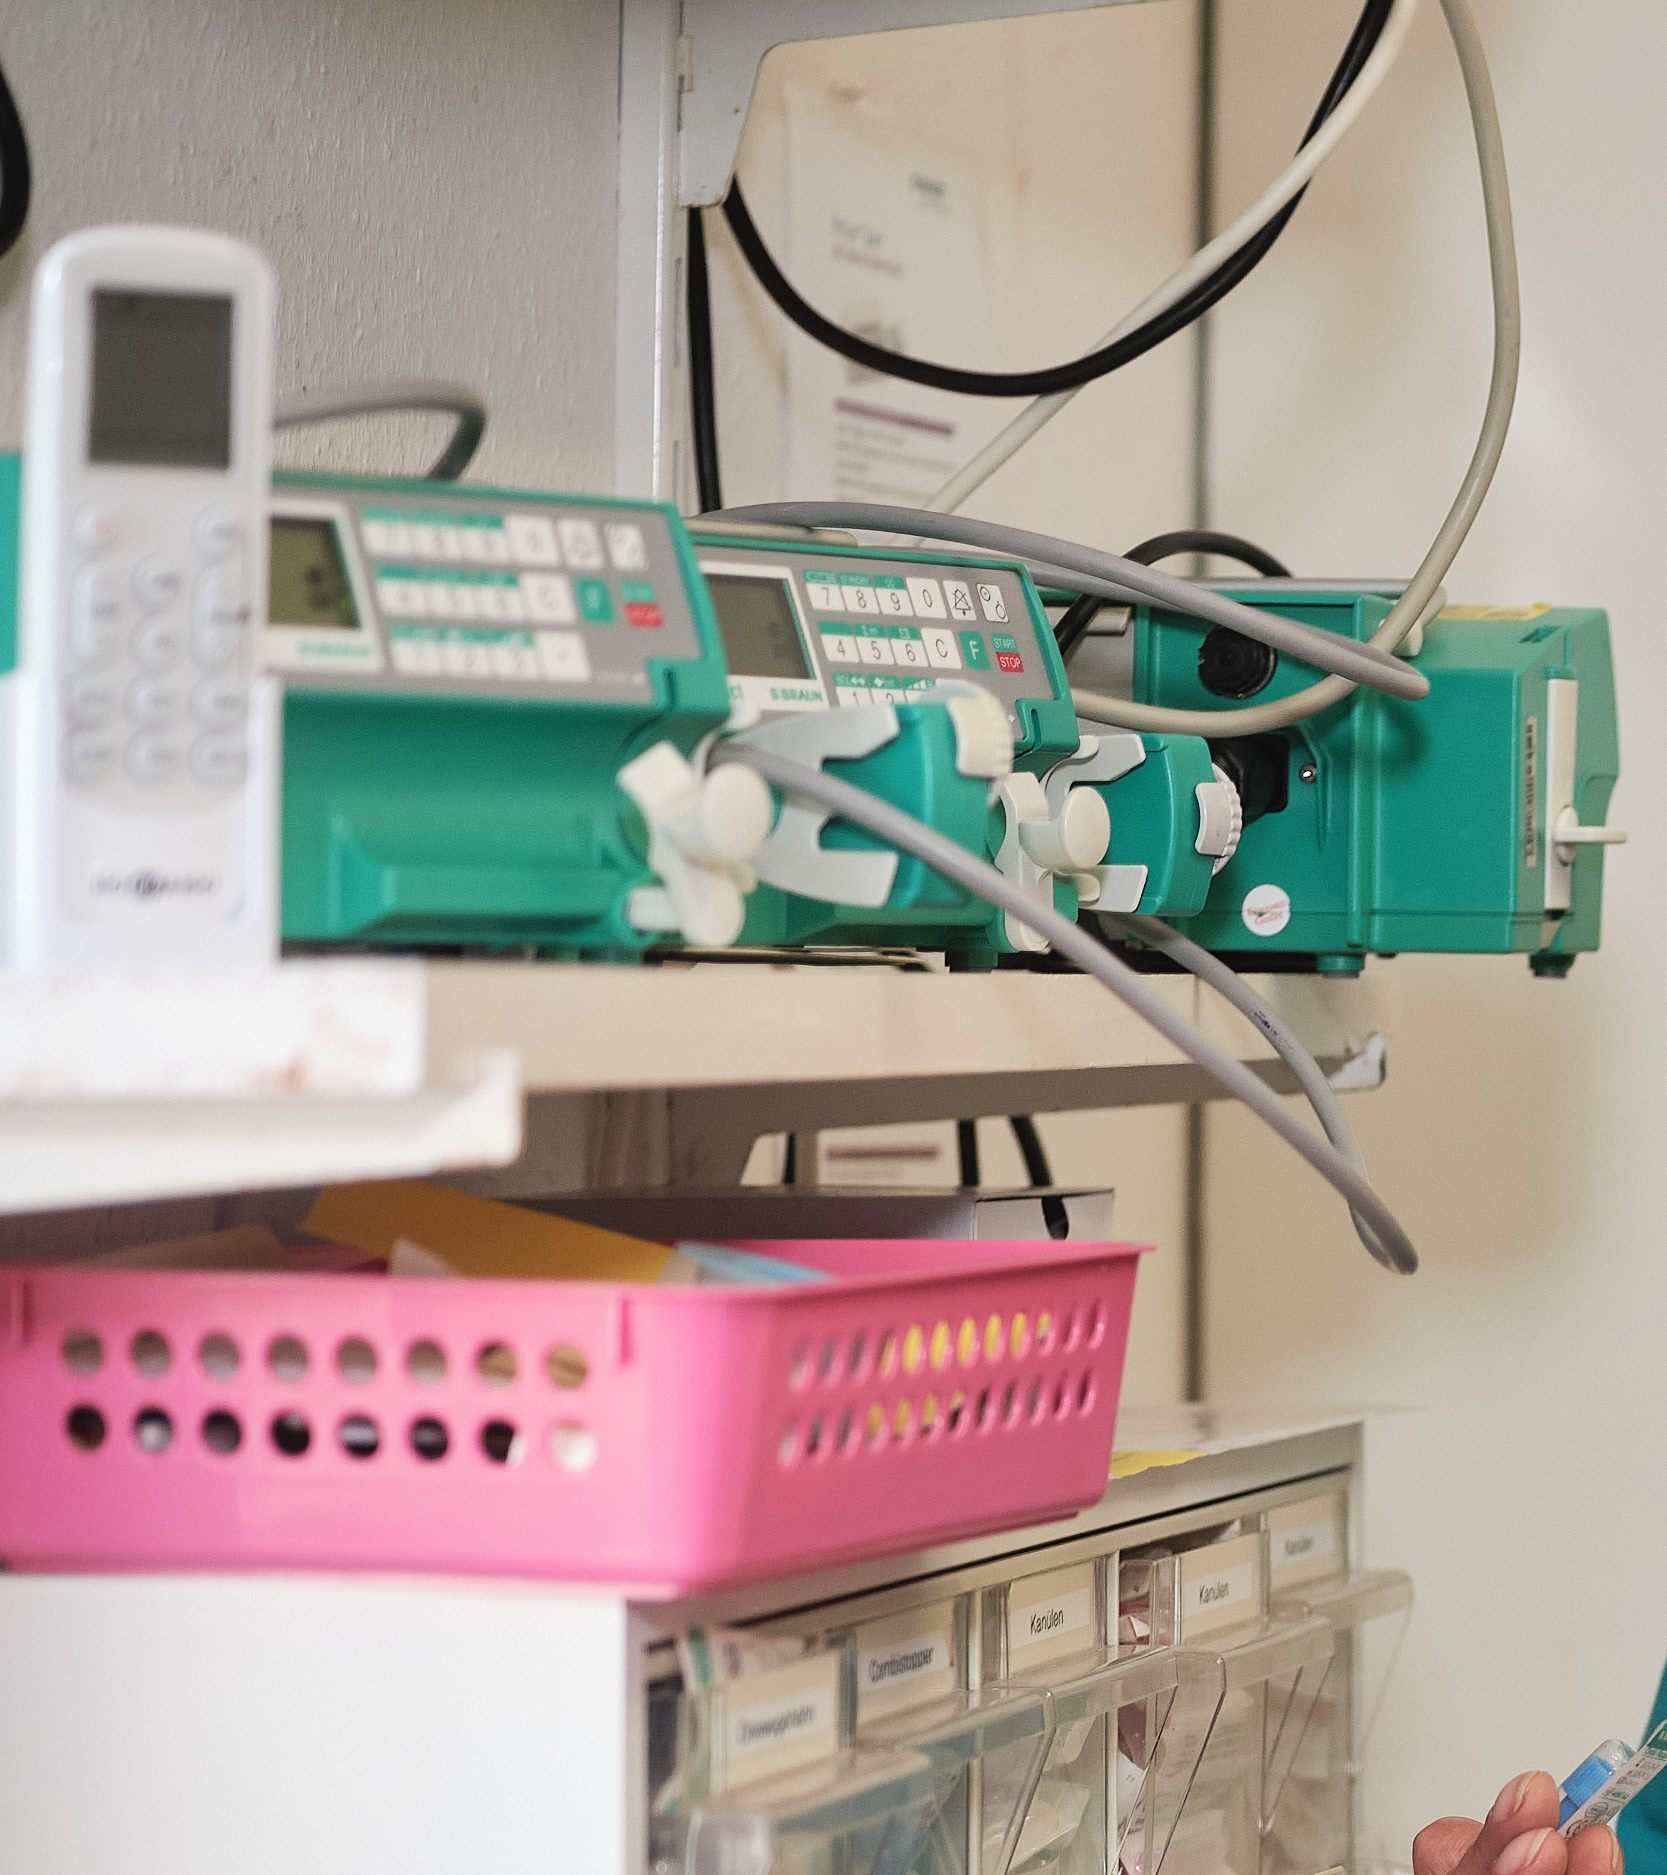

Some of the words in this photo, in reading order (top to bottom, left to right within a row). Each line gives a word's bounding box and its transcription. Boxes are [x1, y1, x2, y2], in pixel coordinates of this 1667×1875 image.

[820, 587, 830, 606] 7
[856, 590, 867, 609] 8
[890, 592, 901, 612] 9
[922, 589, 933, 608] 0
[836, 640, 847, 657] 4
[870, 641, 882, 660] 5
[905, 643, 917, 662] 6
[935, 639, 948, 659] C
[969, 641, 980, 659] F
[993, 636, 1017, 650] START
[999, 656, 1021, 670] STOP
[1200, 1579, 1230, 1604] Kanülen
[1030, 1609, 1064, 1635] Kanülen
